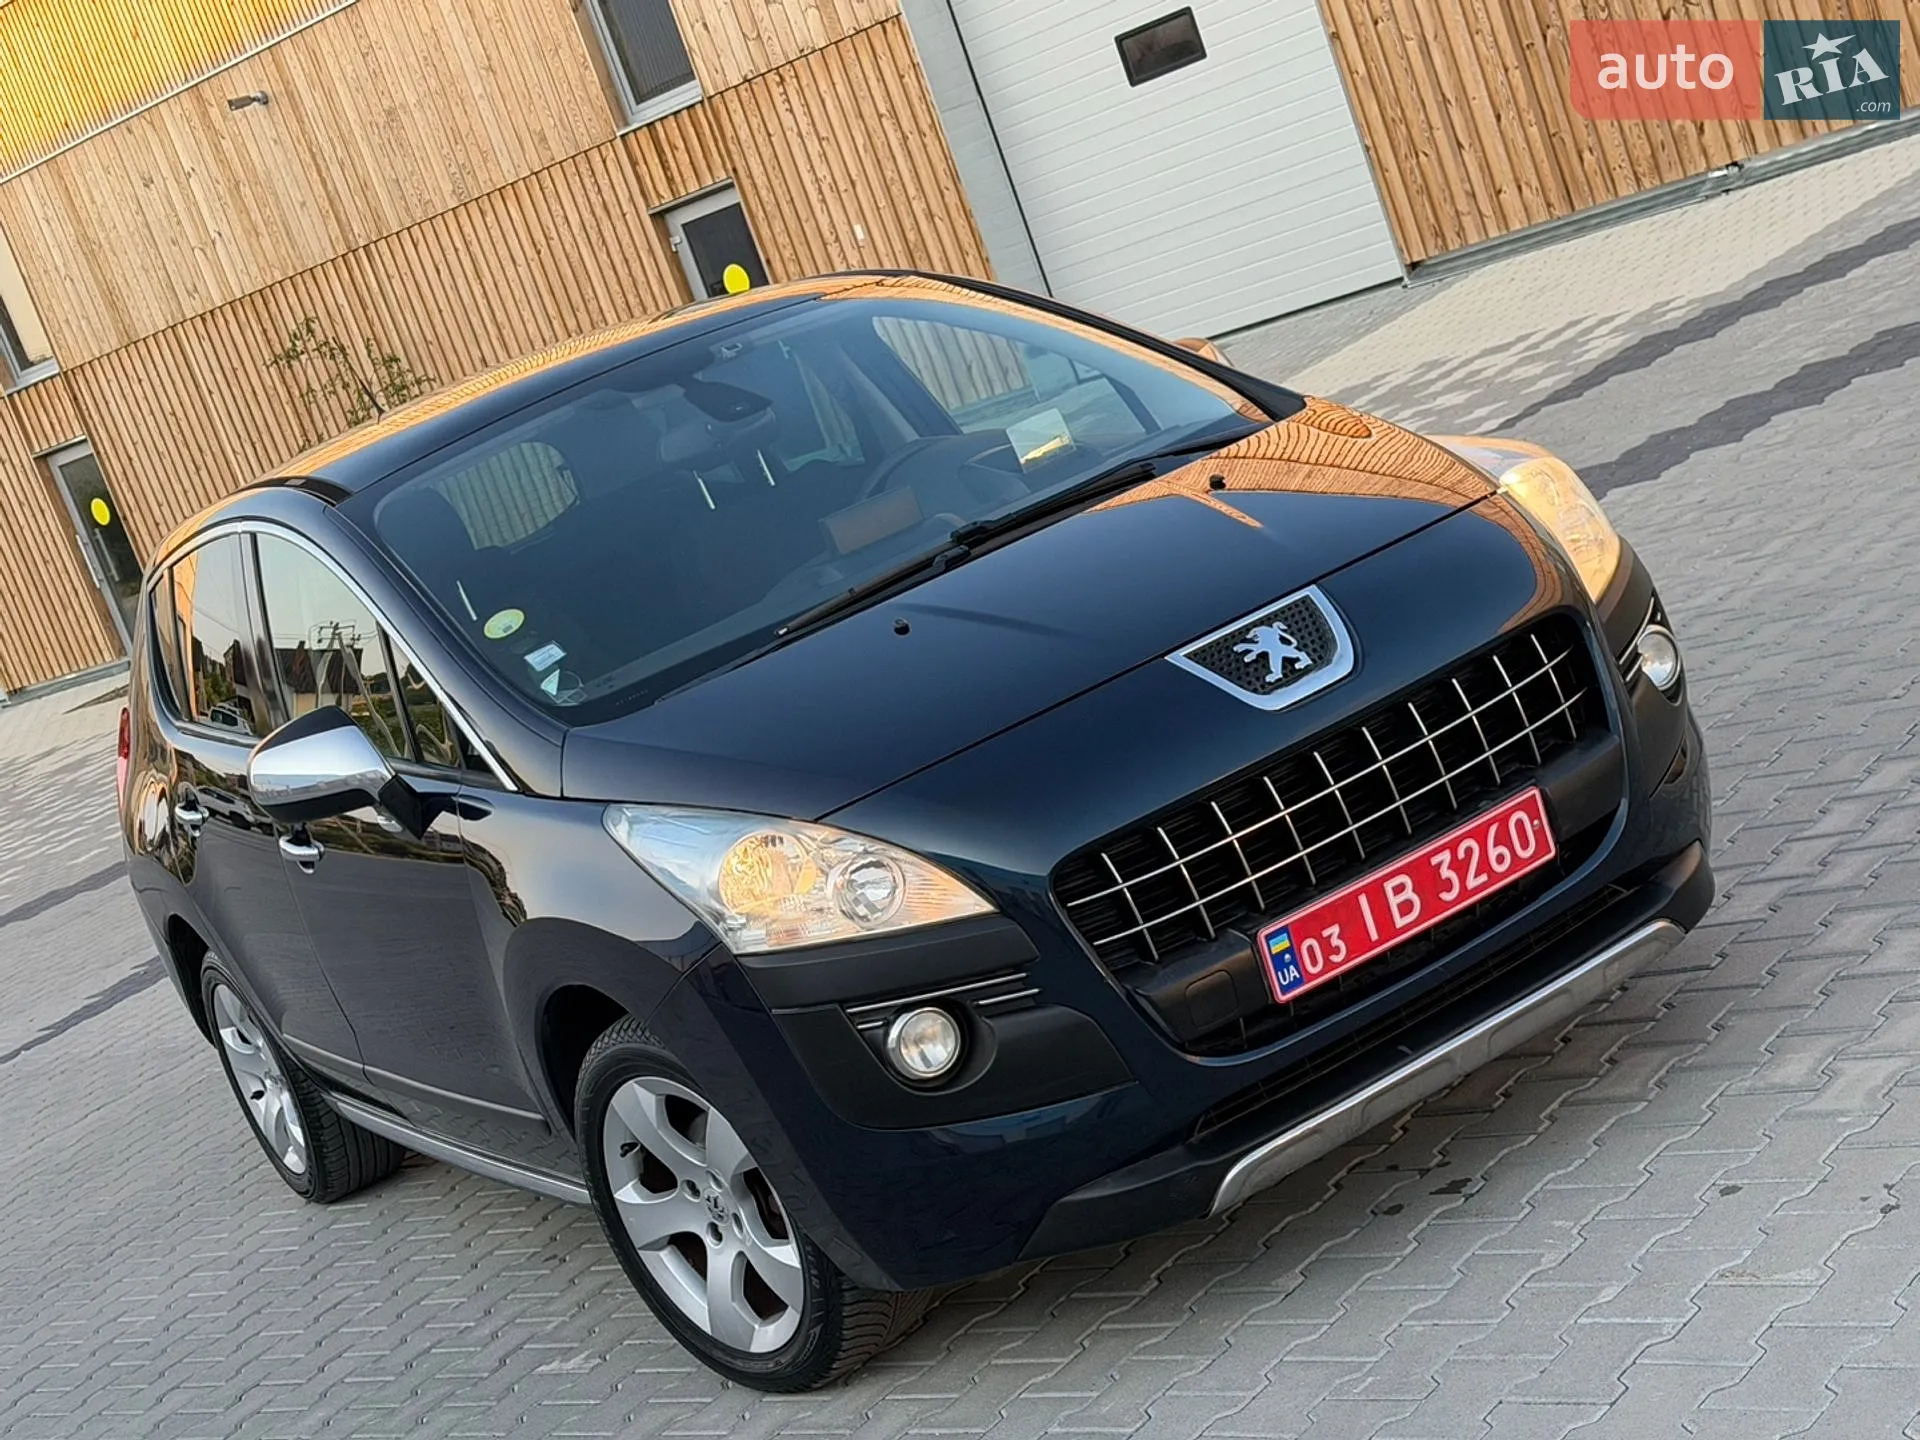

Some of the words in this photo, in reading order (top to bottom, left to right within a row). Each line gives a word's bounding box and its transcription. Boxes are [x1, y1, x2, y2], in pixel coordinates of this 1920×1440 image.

[1300, 923, 1347, 975] 03
[1357, 873, 1422, 942] IB
[1430, 809, 1536, 902] 3260
[1278, 964, 1300, 985] UA
